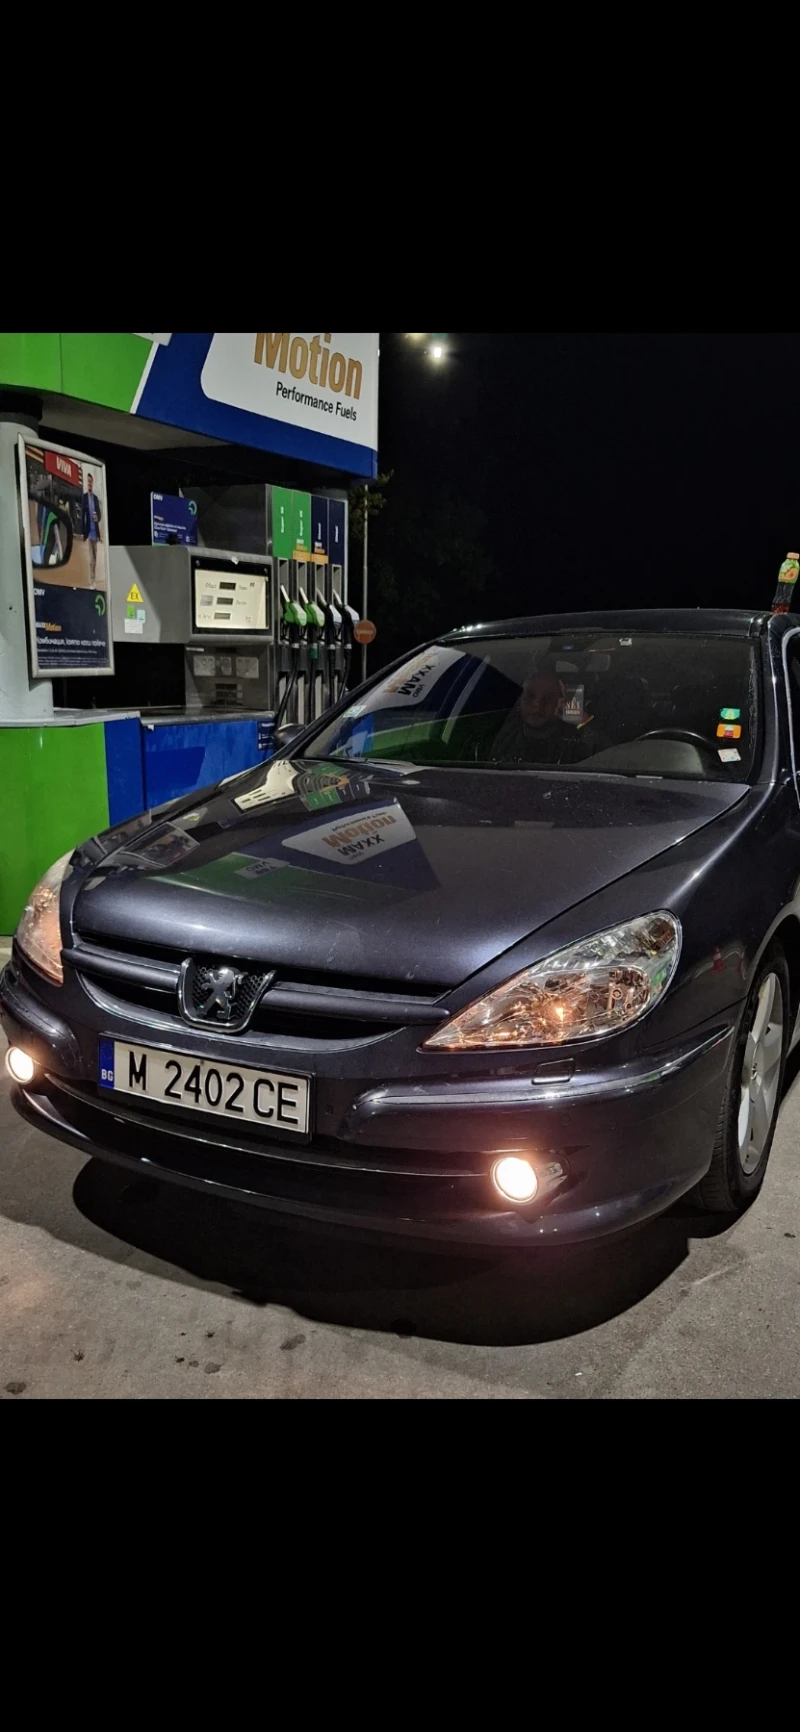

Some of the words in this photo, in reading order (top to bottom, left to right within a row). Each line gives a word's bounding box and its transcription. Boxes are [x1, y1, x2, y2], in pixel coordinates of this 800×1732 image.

[254, 333, 363, 400] Motion
[276, 381, 333, 413] Performance
[335, 401, 357, 421] Fuels
[56, 456, 72, 478] VIVA
[101, 1068, 114, 1082] BG
[128, 1051, 147, 1091] M
[164, 1060, 244, 1113] 2402
[253, 1078, 299, 1125] CE
